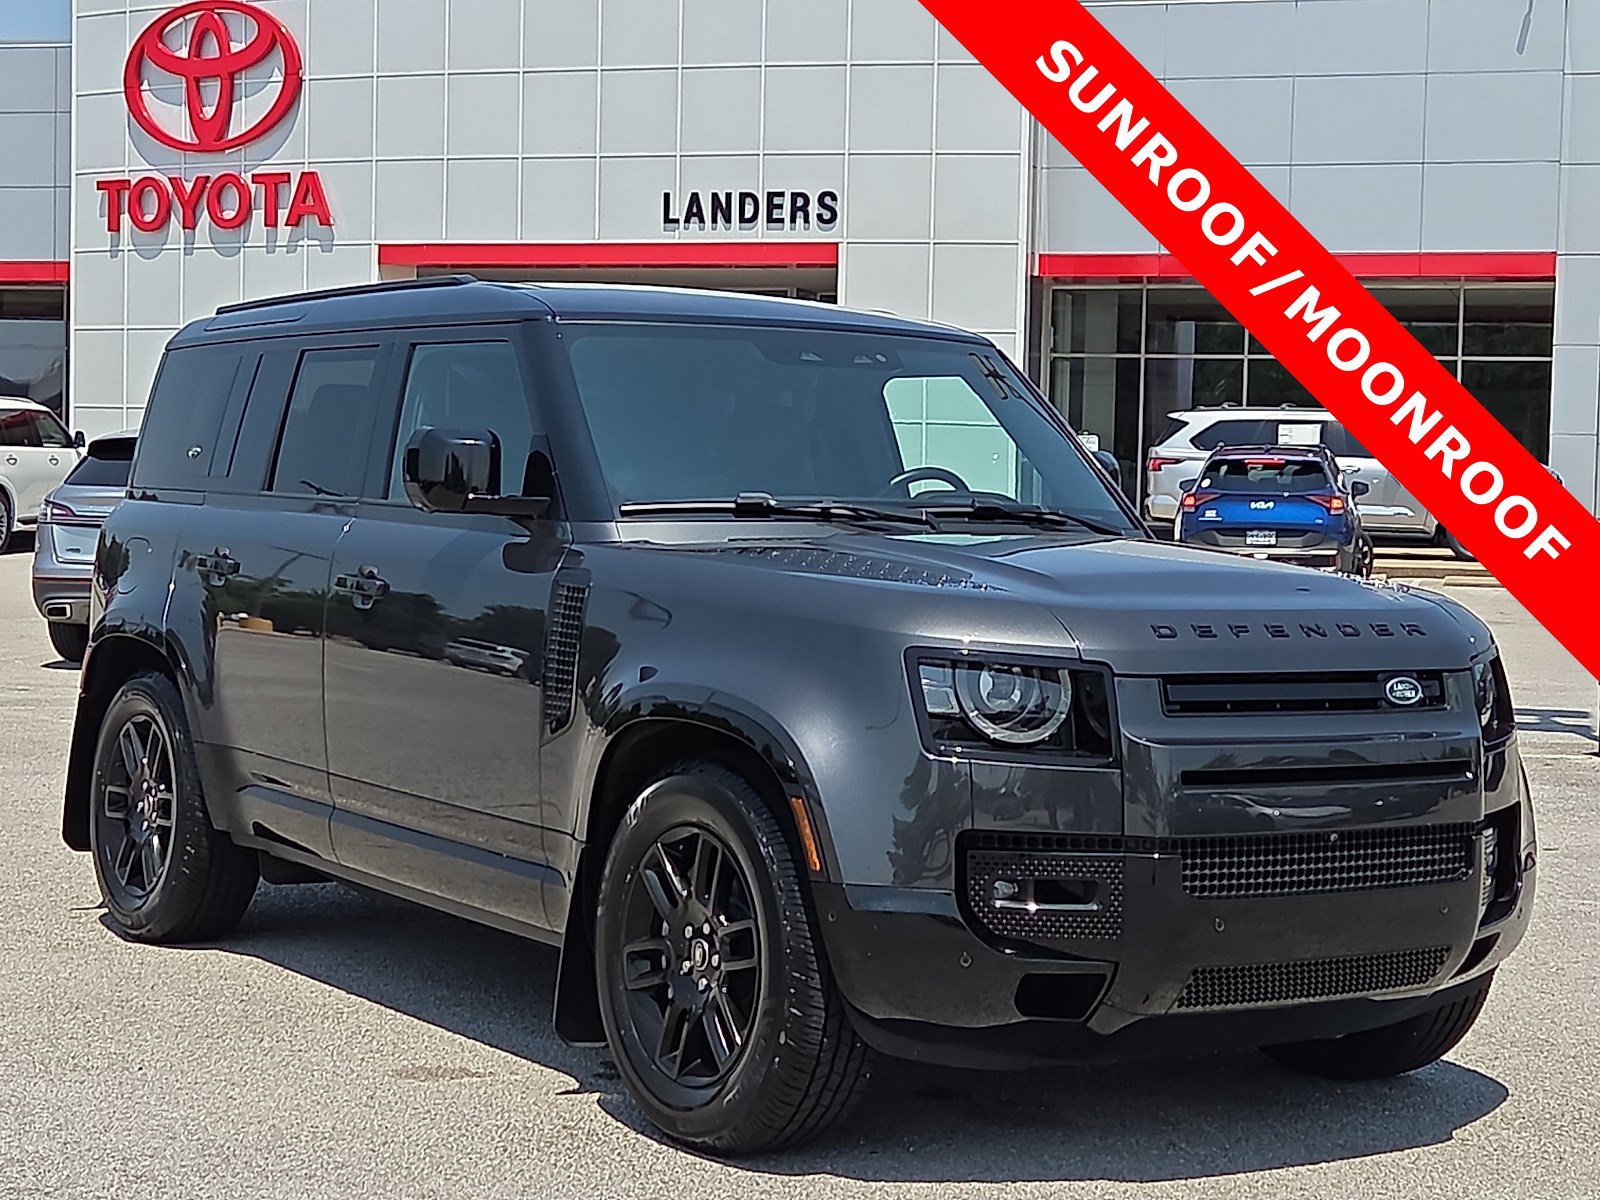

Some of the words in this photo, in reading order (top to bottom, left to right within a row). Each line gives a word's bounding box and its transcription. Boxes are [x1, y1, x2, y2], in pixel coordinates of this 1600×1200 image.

[97, 171, 334, 233] TOYOTA
[662, 190, 838, 226] LANDERS
[1150, 622, 1427, 639] DEFENDER
